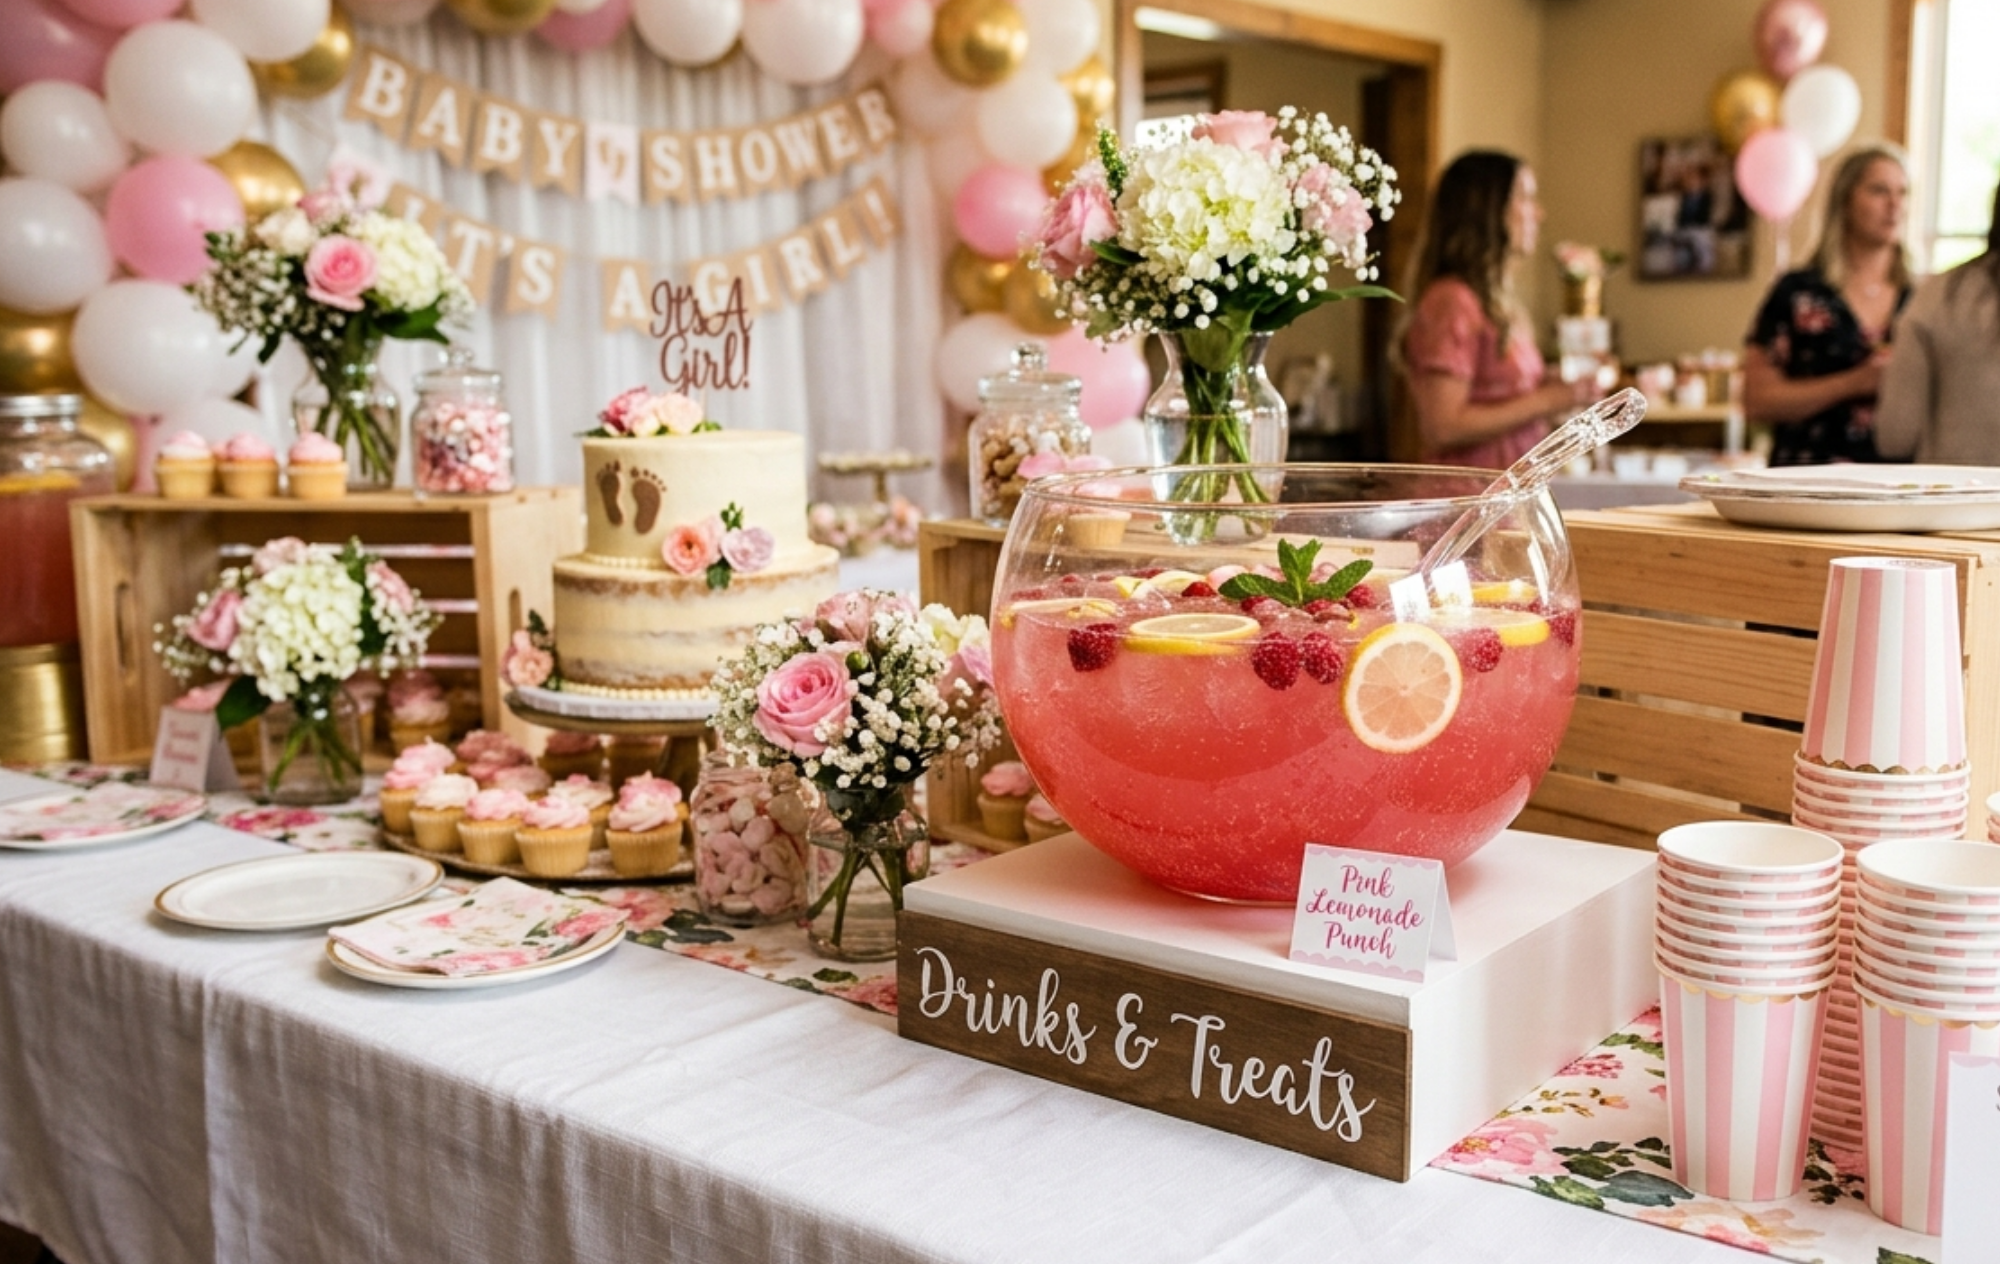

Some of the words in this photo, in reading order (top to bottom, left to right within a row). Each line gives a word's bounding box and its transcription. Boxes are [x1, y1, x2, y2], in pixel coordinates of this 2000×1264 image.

[359, 52, 578, 178] BABY
[651, 89, 896, 190] SHOWER
[609, 265, 648, 319] A
[694, 188, 895, 317] GIRL!
[700, 276, 753, 337] A
[661, 330, 750, 397] Girl!
[1305, 888, 1425, 931] Lemonade
[1323, 920, 1398, 960] Punch
[914, 945, 1097, 1065] Drinks
[1114, 992, 1159, 1071] &
[1170, 1013, 1376, 1142] Treats
